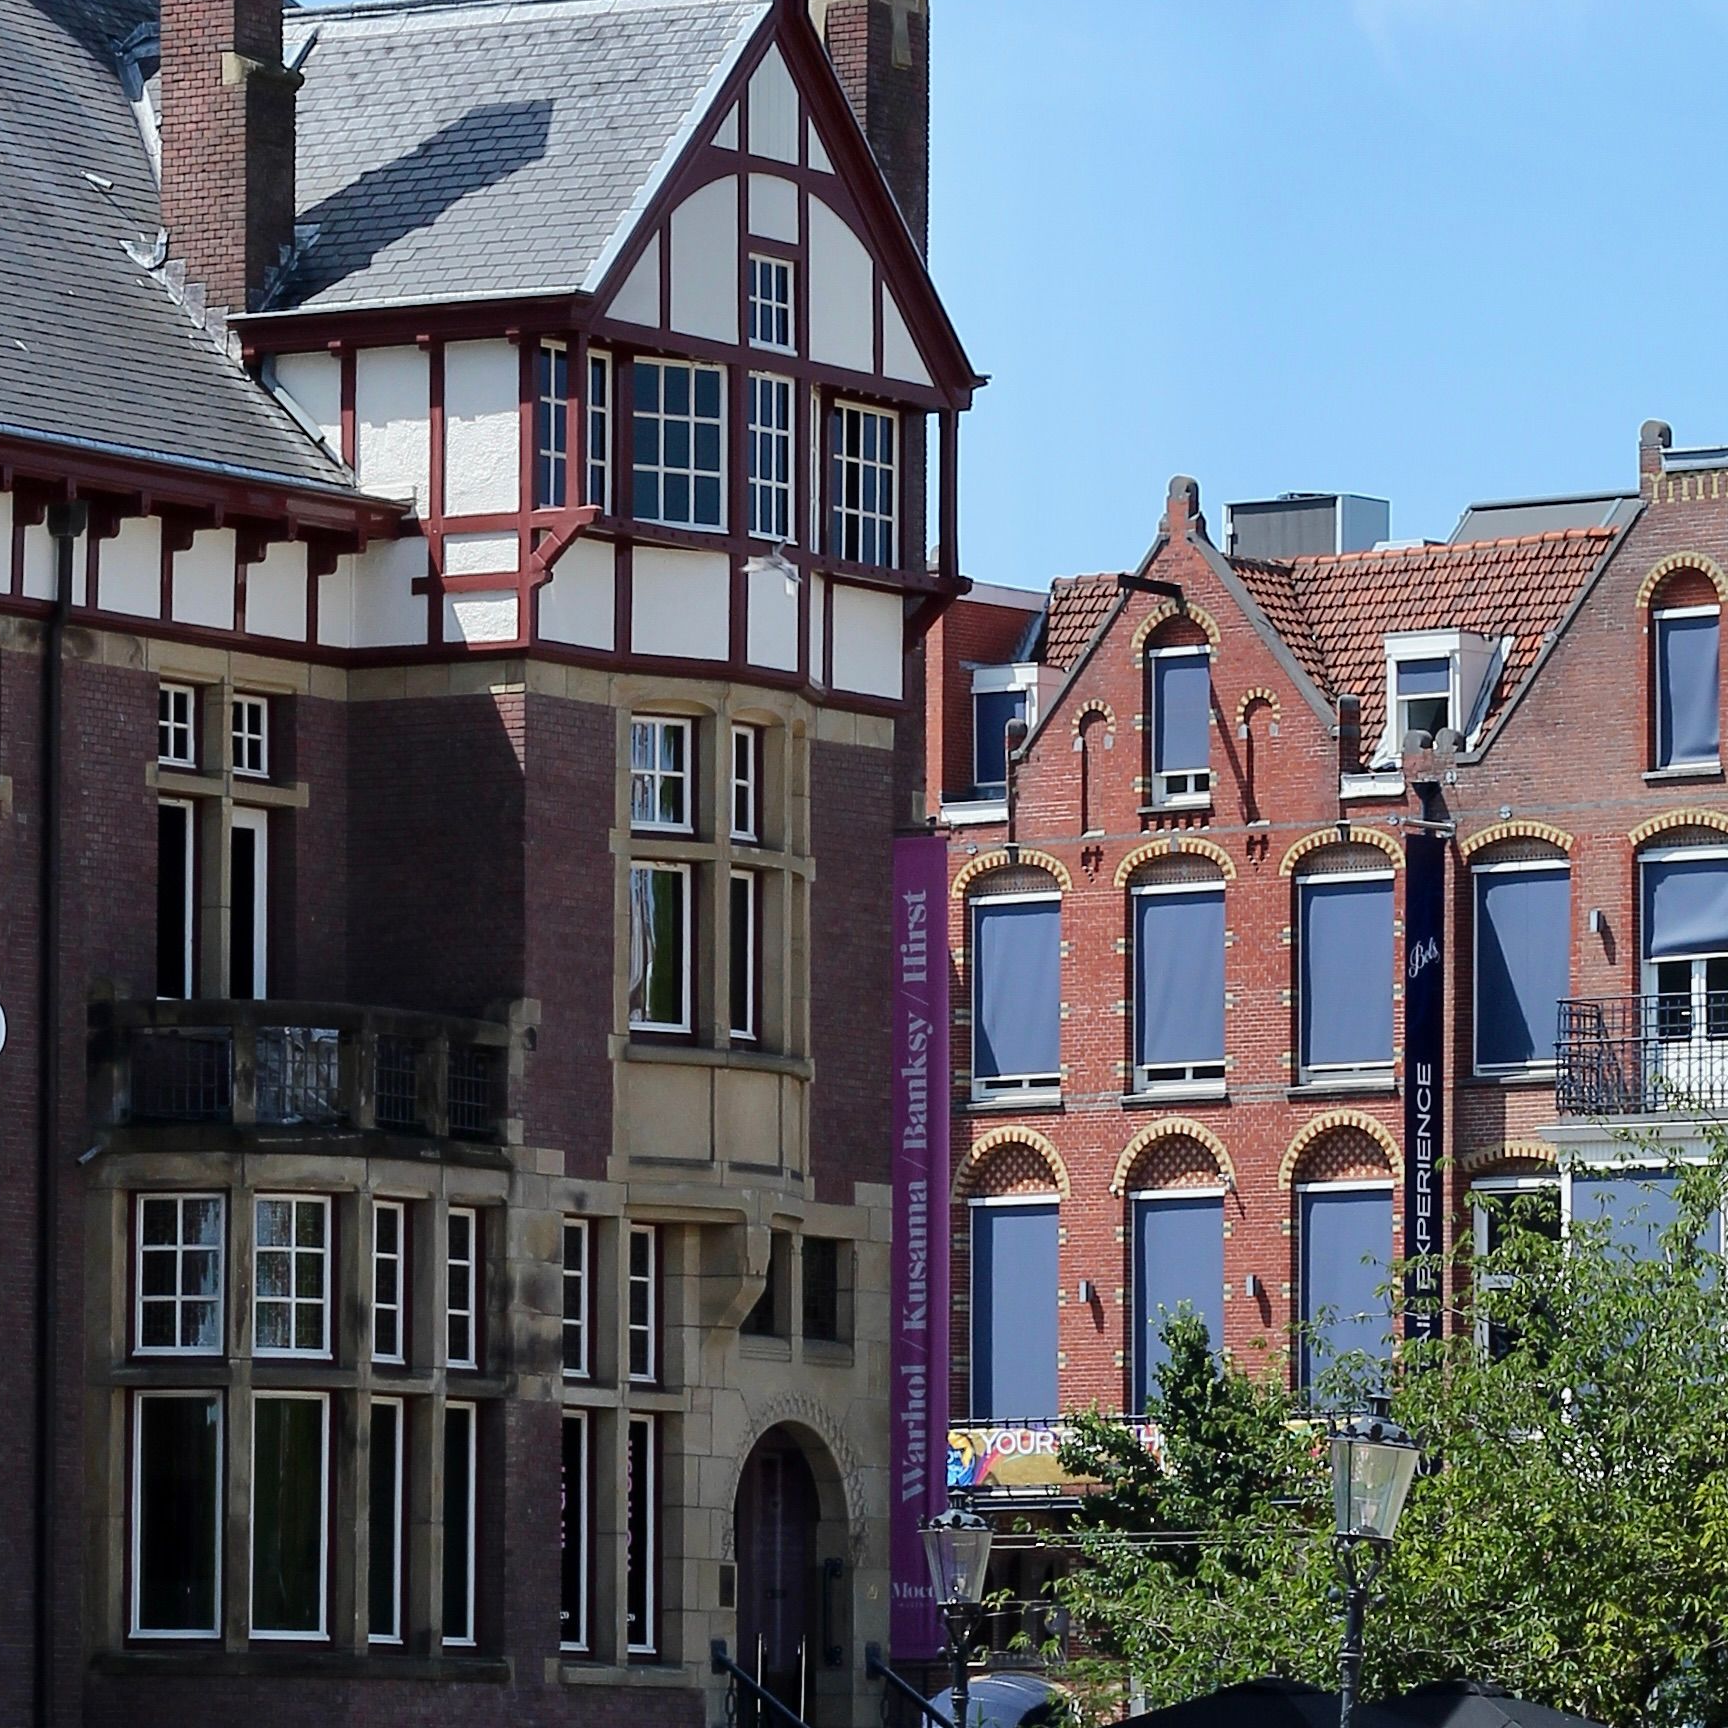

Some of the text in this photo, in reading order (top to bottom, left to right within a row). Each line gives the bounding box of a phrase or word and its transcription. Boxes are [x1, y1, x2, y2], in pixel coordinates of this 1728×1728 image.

[900, 889, 928, 984] Hirst
[900, 1011, 934, 1151] Banksy
[902, 1178, 928, 1332] Kusama
[900, 1364, 928, 1503] Warhol
[979, 1431, 1056, 1456] YOUR
